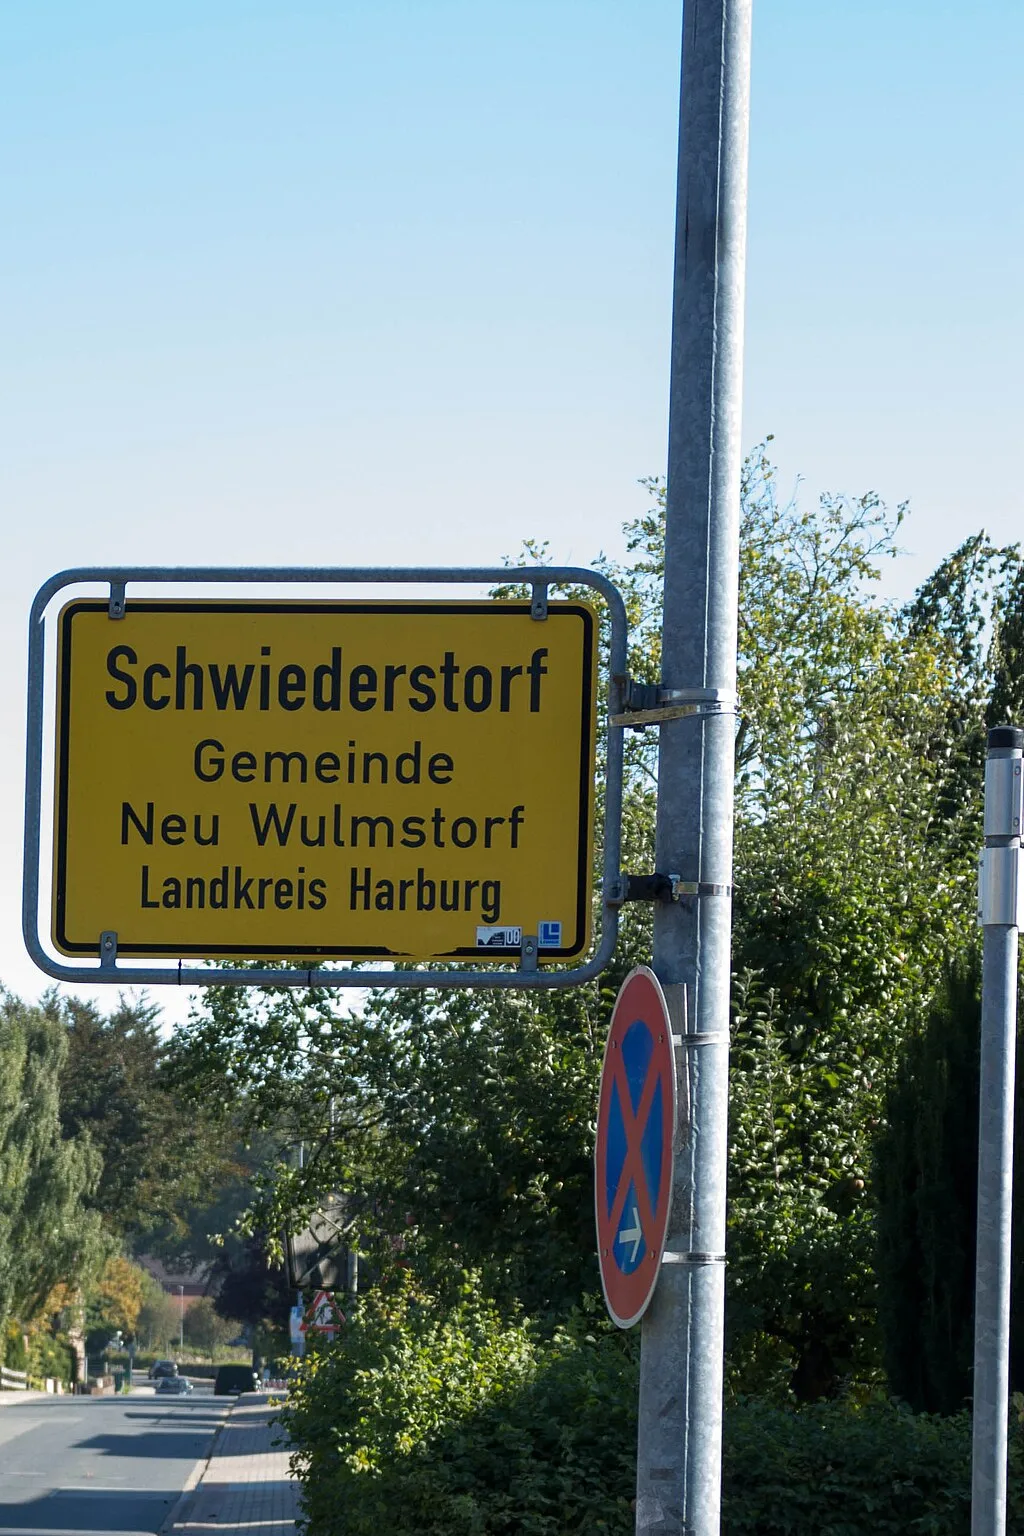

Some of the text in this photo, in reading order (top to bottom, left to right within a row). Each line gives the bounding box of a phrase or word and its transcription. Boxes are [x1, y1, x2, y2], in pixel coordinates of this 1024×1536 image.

[105, 644, 549, 713] Schwiederstorf
[193, 738, 455, 786] Gemeinde
[120, 801, 525, 849] Neu Wulmstorf
[139, 865, 502, 924] Landkreis Harburg
